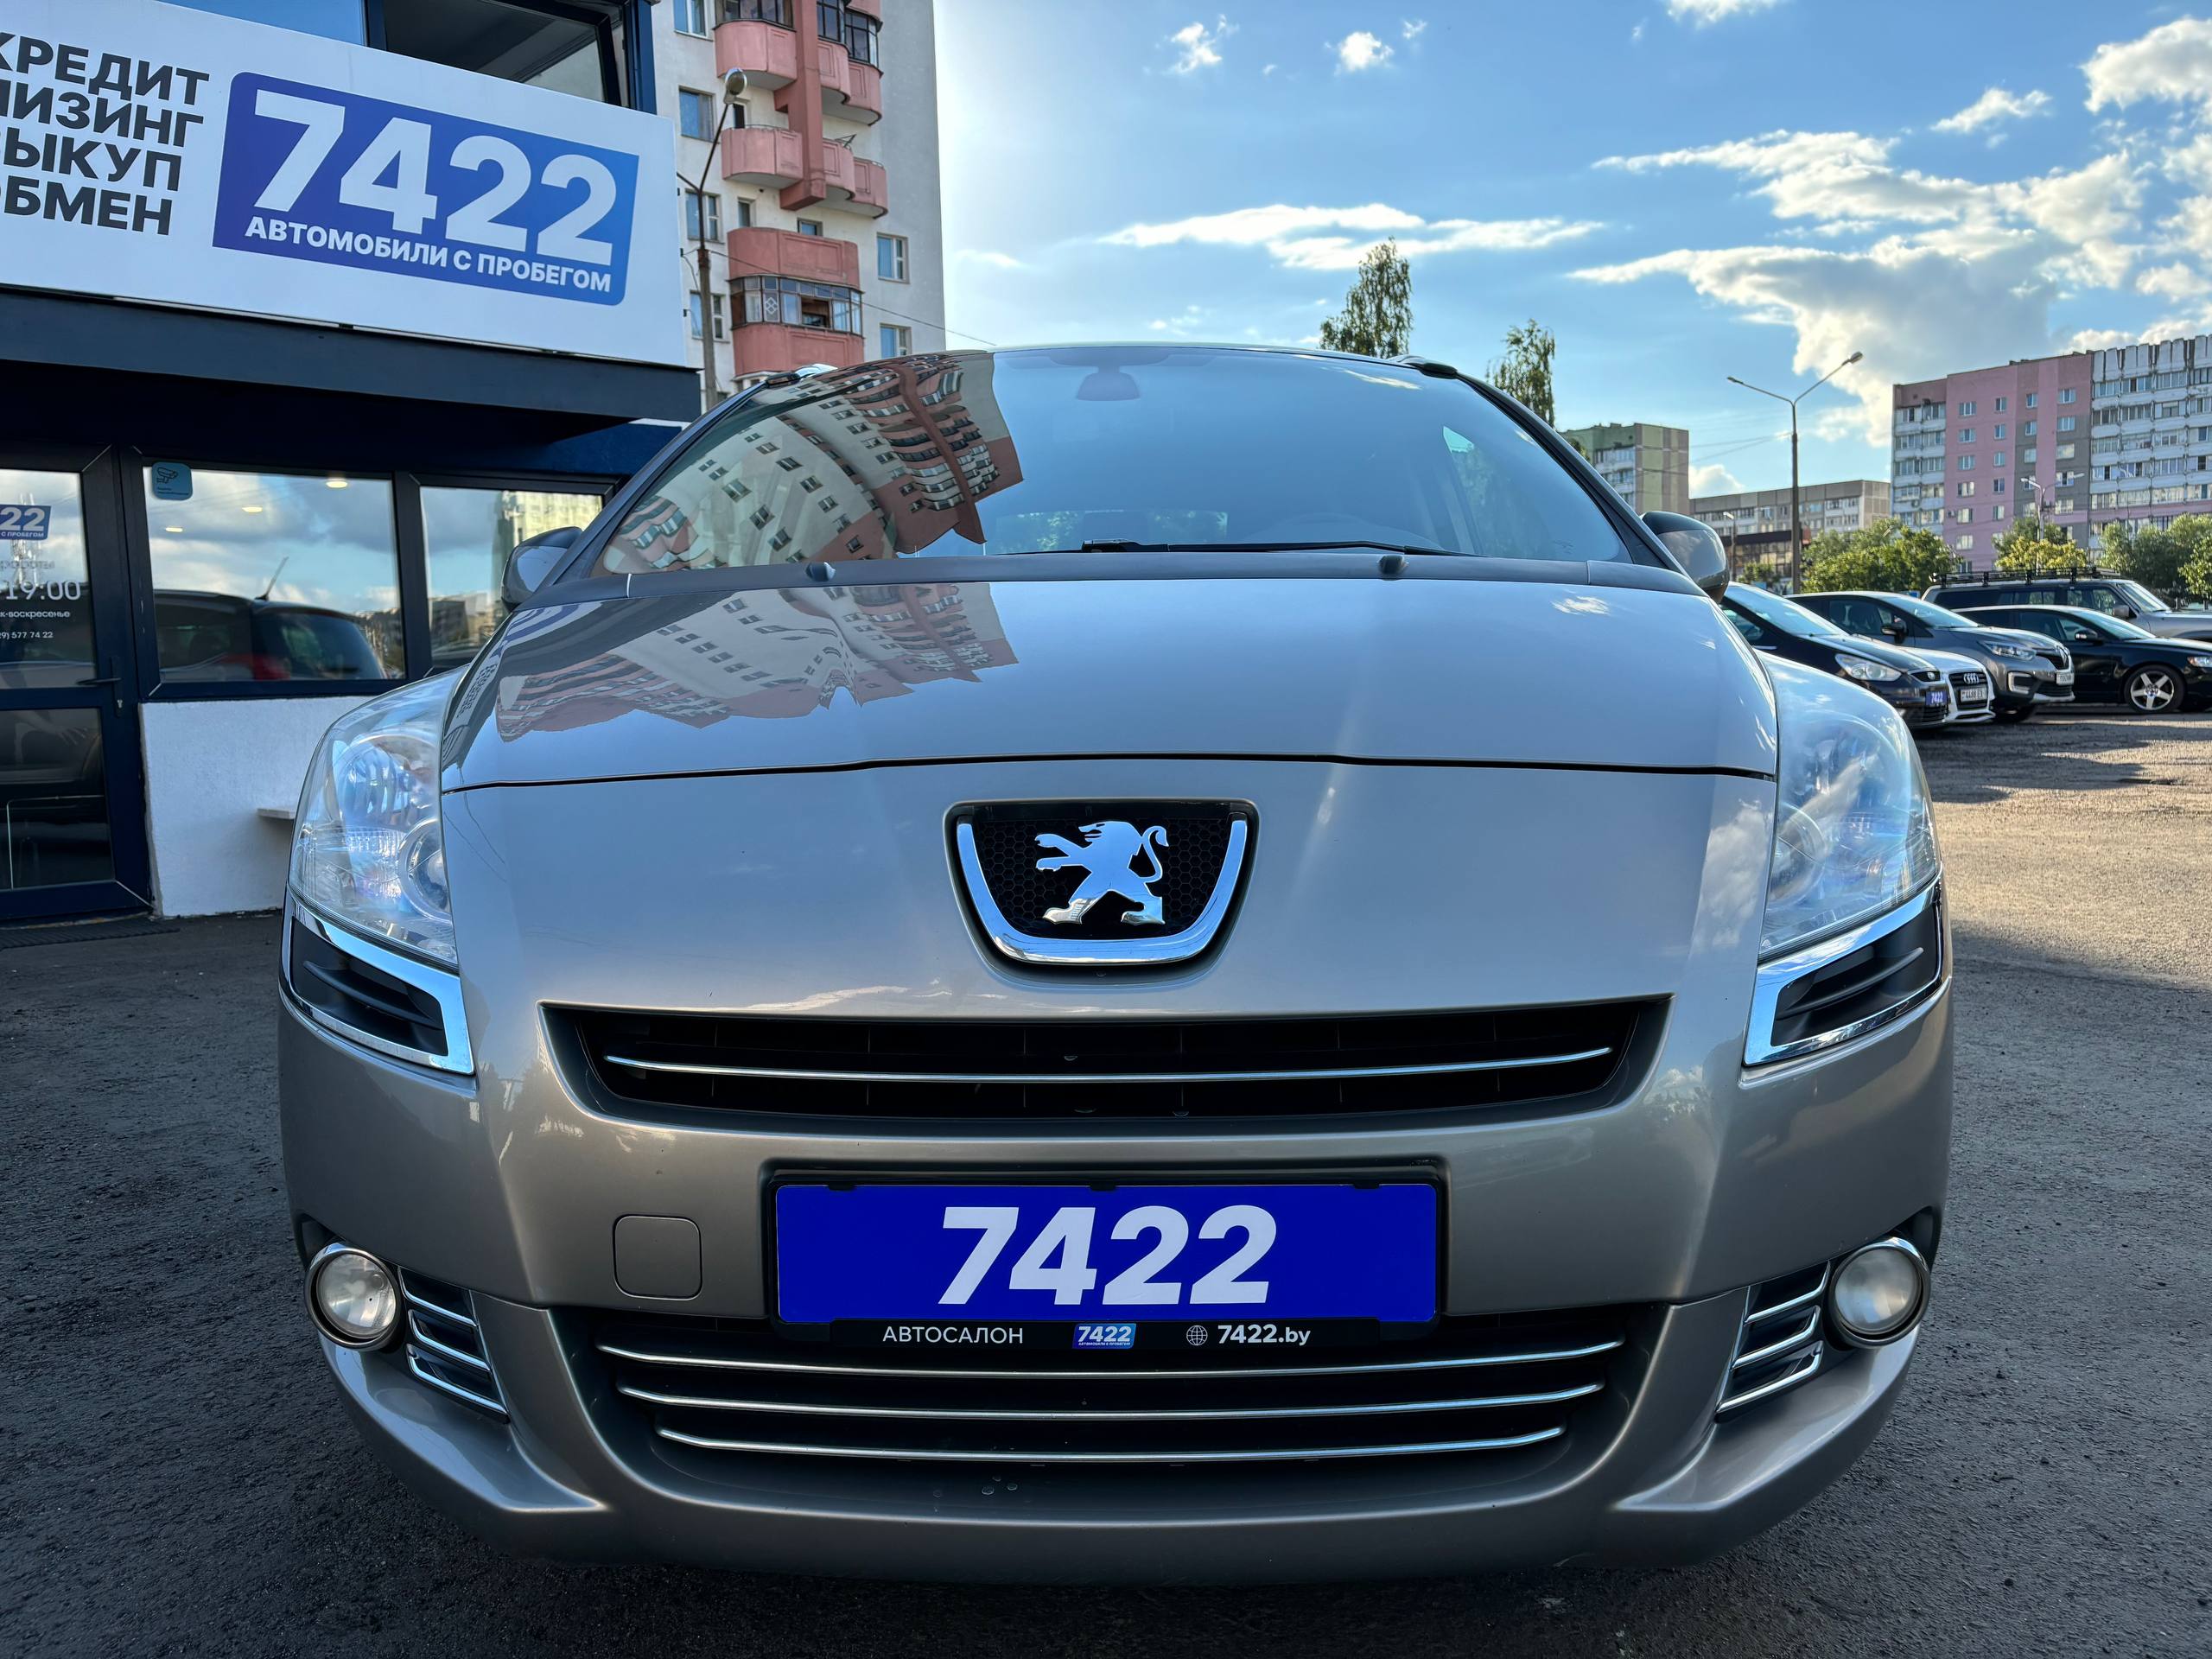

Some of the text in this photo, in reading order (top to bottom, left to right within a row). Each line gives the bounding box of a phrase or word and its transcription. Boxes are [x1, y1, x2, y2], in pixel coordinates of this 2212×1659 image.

[0, 79, 204, 148] ИЗИНГ
[0, 126, 182, 192] ЫКУП
[254, 89, 617, 266] 7422
[0, 175, 173, 236] БМЕН
[245, 216, 612, 293] АВТОМОБИЛИ С ПРОБЕГОМ
[0, 506, 45, 531] 22
[0, 611, 71, 620] к-воскресенье
[938, 1205, 1277, 1305] 7422
[881, 1325, 1024, 1344] АВТОСАЛОН
[1078, 1325, 1132, 1342] 7422
[1217, 1324, 1311, 1345] 7422.by
